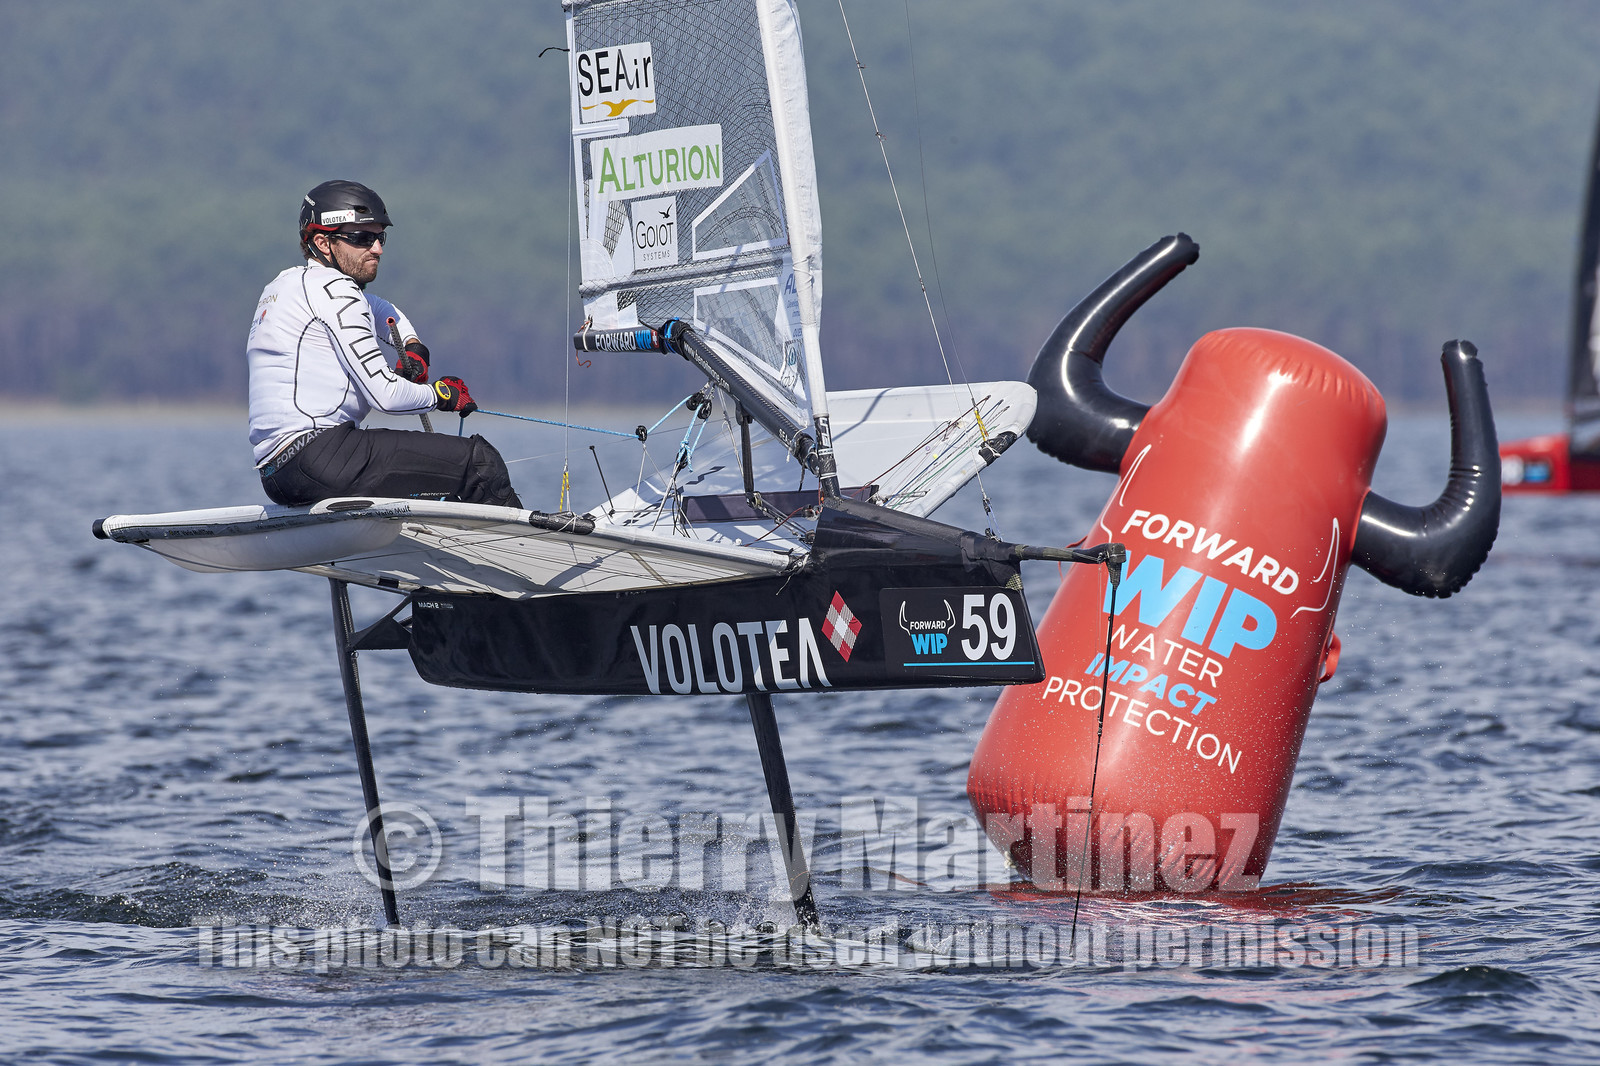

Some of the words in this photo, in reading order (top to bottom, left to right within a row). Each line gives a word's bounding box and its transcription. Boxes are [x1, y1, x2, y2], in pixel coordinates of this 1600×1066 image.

[578, 48, 651, 97] SEAir
[598, 144, 720, 194] ALTURION
[642, 250, 671, 262] SYSTEMS
[594, 331, 637, 352] FORWARD
[635, 329, 652, 350] WIP
[1120, 509, 1300, 596] FORWARD
[909, 619, 947, 631] FORWARD
[961, 593, 1018, 661] 59
[1103, 549, 1278, 659] WIP
[630, 617, 833, 695] VOLOTEA
[911, 632, 949, 655] WIP
[1084, 652, 1218, 716] IMPACT
[1042, 676, 1242, 774] PROTECTION
